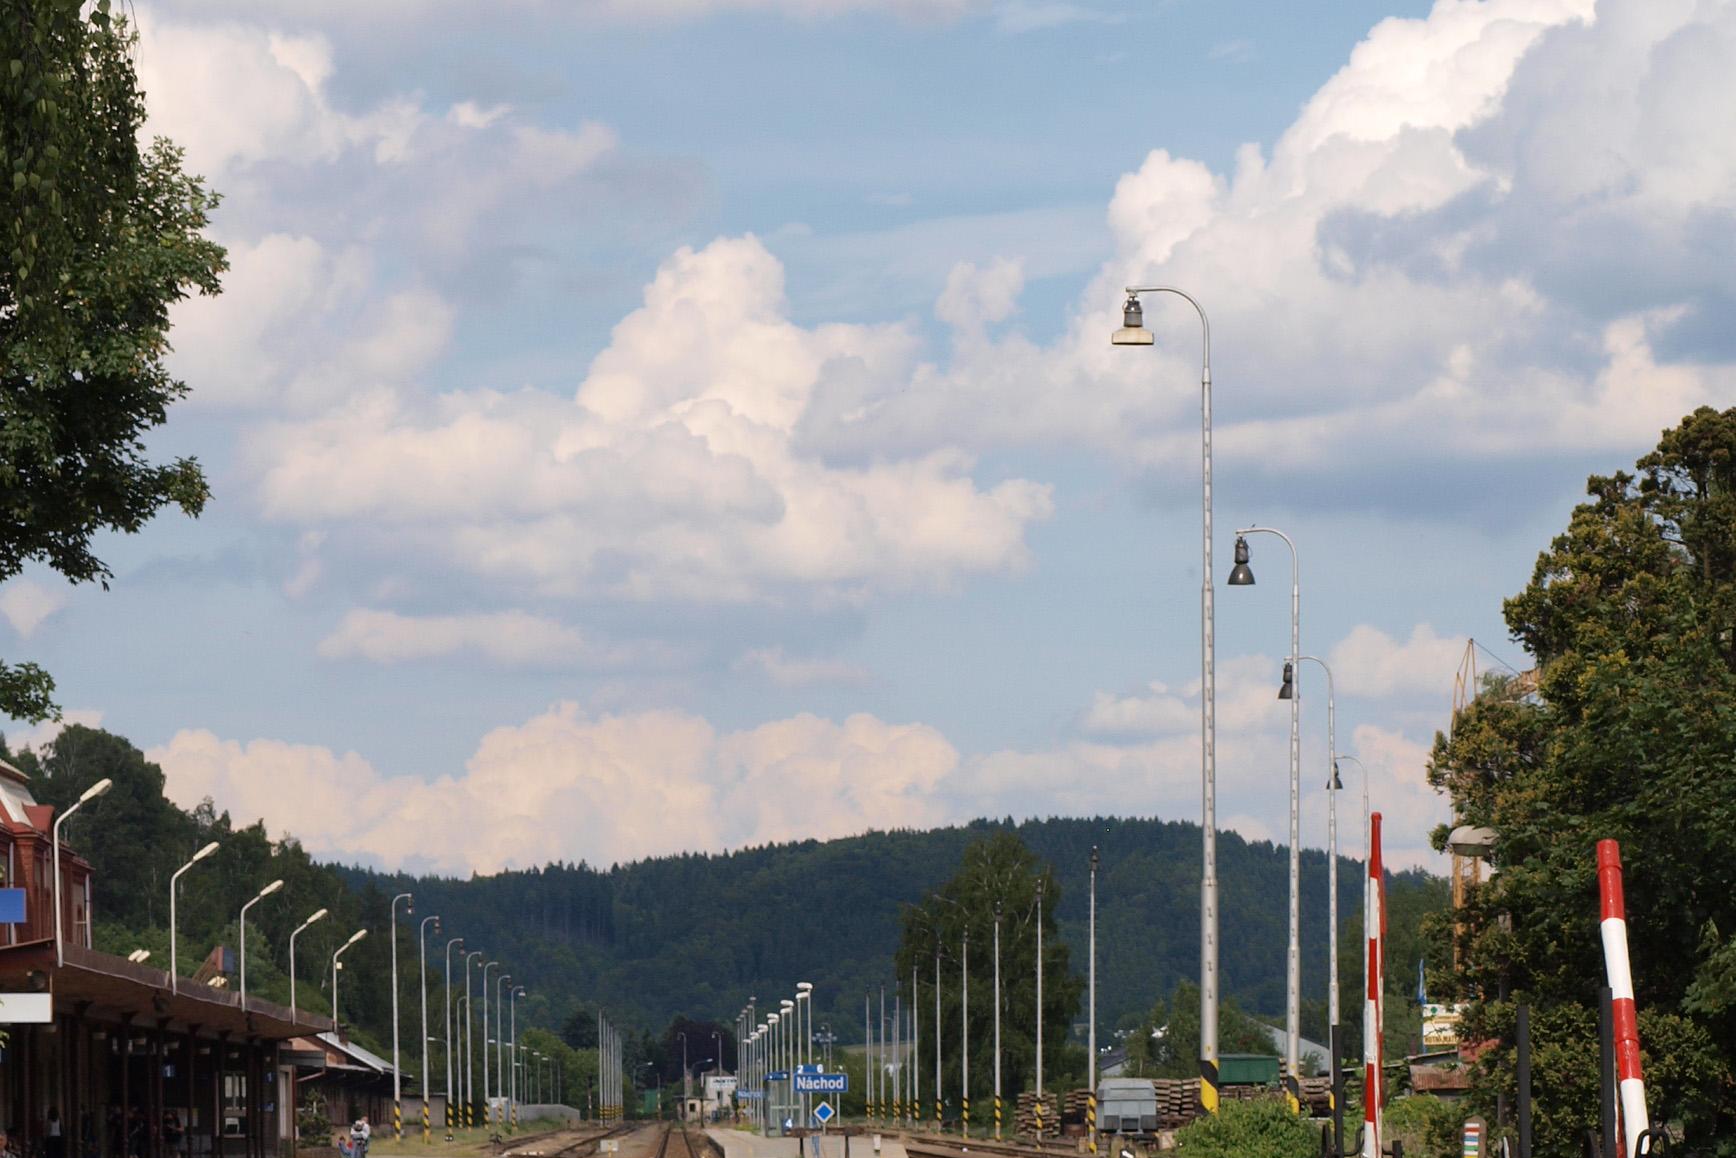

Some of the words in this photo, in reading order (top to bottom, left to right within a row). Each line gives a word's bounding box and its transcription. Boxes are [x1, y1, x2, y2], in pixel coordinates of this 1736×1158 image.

[797, 1064, 804, 1074] 2
[796, 1076, 844, 1089] Náchod
[785, 1118, 793, 1128] 4
